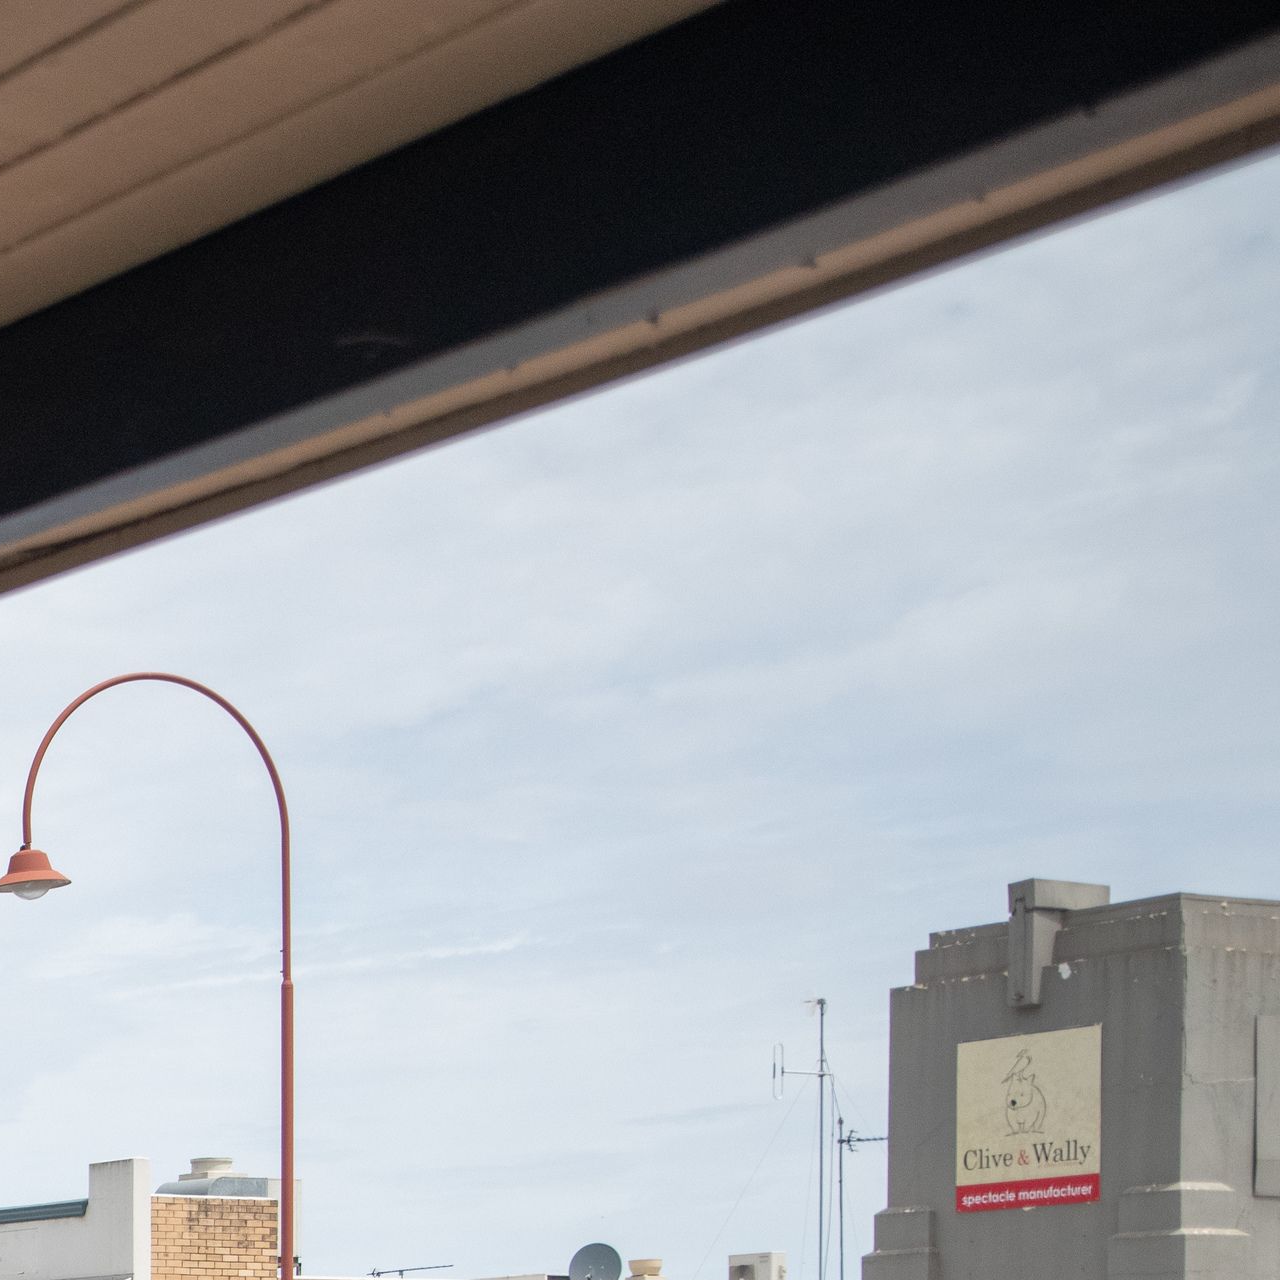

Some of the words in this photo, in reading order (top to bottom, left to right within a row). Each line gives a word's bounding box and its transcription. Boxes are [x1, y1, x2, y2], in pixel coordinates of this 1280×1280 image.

[963, 1148, 1013, 1171] Clive
[1017, 1149, 1029, 1166] &
[1033, 1139, 1091, 1165] Wally
[961, 1190, 1016, 1207] spectacle
[1018, 1184, 1093, 1200] manufacturer
